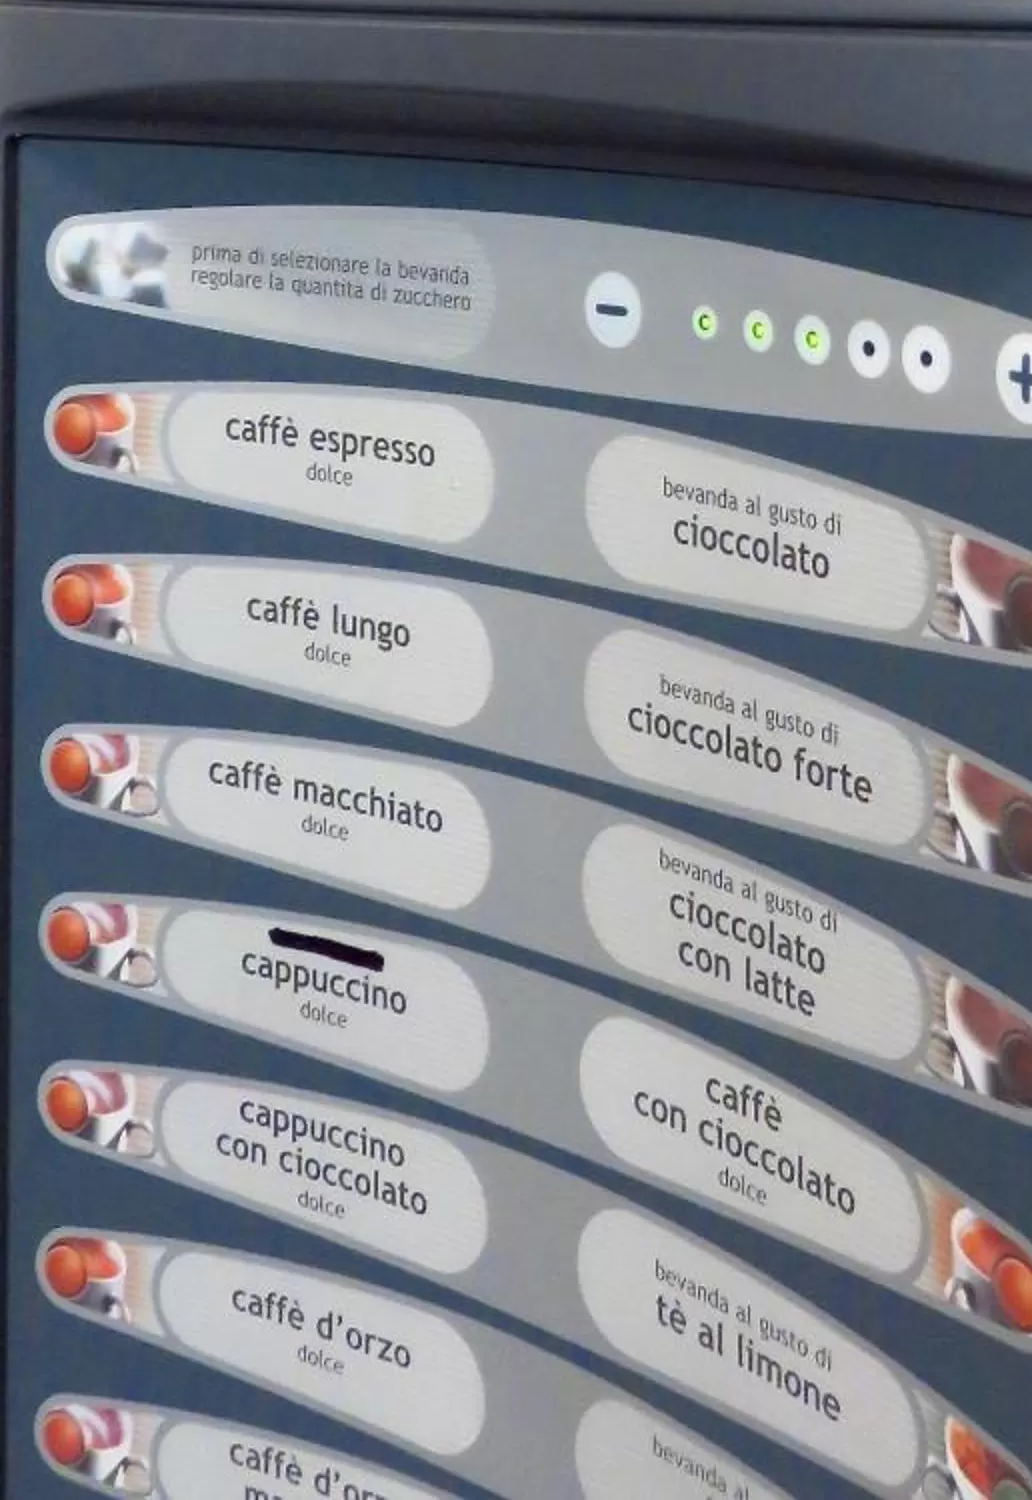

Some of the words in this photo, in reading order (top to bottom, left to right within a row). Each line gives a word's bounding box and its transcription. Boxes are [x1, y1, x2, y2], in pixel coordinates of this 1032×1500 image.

[191, 244, 241, 264] prima
[248, 247, 264, 265] di
[271, 249, 369, 276] selezionare
[375, 257, 391, 277] la
[398, 260, 470, 286] bevanda
[191, 268, 263, 291] regolare
[269, 271, 285, 291] la
[370, 282, 387, 302] di
[393, 287, 472, 311] zucchero
[225, 413, 300, 448] caffè
[309, 426, 436, 468] espresso
[306, 462, 354, 487] dolce
[662, 475, 739, 513] bevanda
[745, 494, 762, 516] al
[768, 501, 818, 530] gusto
[824, 512, 842, 538] di
[672, 512, 831, 579] cioccolato
[246, 595, 320, 631] caffè
[332, 604, 411, 652] lungo
[304, 642, 352, 668] dolce
[659, 673, 736, 716] bevanda
[741, 697, 758, 722] al
[765, 706, 816, 739] gusto
[821, 722, 840, 747] di
[628, 702, 782, 774] cioccolato
[793, 746, 873, 804] forte
[208, 759, 282, 796] caffè
[293, 777, 443, 834] macchiato
[301, 814, 350, 842] dolce
[659, 846, 734, 895] bevanda
[741, 879, 758, 902] al
[764, 888, 814, 924] gusto
[819, 907, 838, 934] di
[669, 889, 827, 976] cioccolato
[241, 950, 408, 1016] cappuccino
[678, 938, 731, 983] con
[744, 957, 816, 1018] latte
[300, 1000, 348, 1030] dolce
[239, 1097, 406, 1168] cappuccino
[704, 1076, 784, 1133] caffè
[215, 1129, 268, 1168] con
[279, 1146, 428, 1216] cioccolato
[633, 1089, 687, 1134] con
[698, 1117, 856, 1217] cioccolato
[297, 1191, 346, 1220] dolce
[717, 1165, 768, 1206] dolce
[231, 1286, 305, 1331] caffè
[654, 1257, 730, 1315] bevanda
[735, 1297, 752, 1325] al
[758, 1316, 809, 1359] gusto
[815, 1345, 833, 1372] di
[297, 1344, 345, 1376] dolce
[655, 1295, 688, 1336] tè
[698, 1320, 724, 1357] al
[736, 1332, 842, 1422] limone
[229, 1441, 304, 1486] caffè
[652, 1433, 728, 1494] bevanda
[733, 1476, 751, 1500] al
